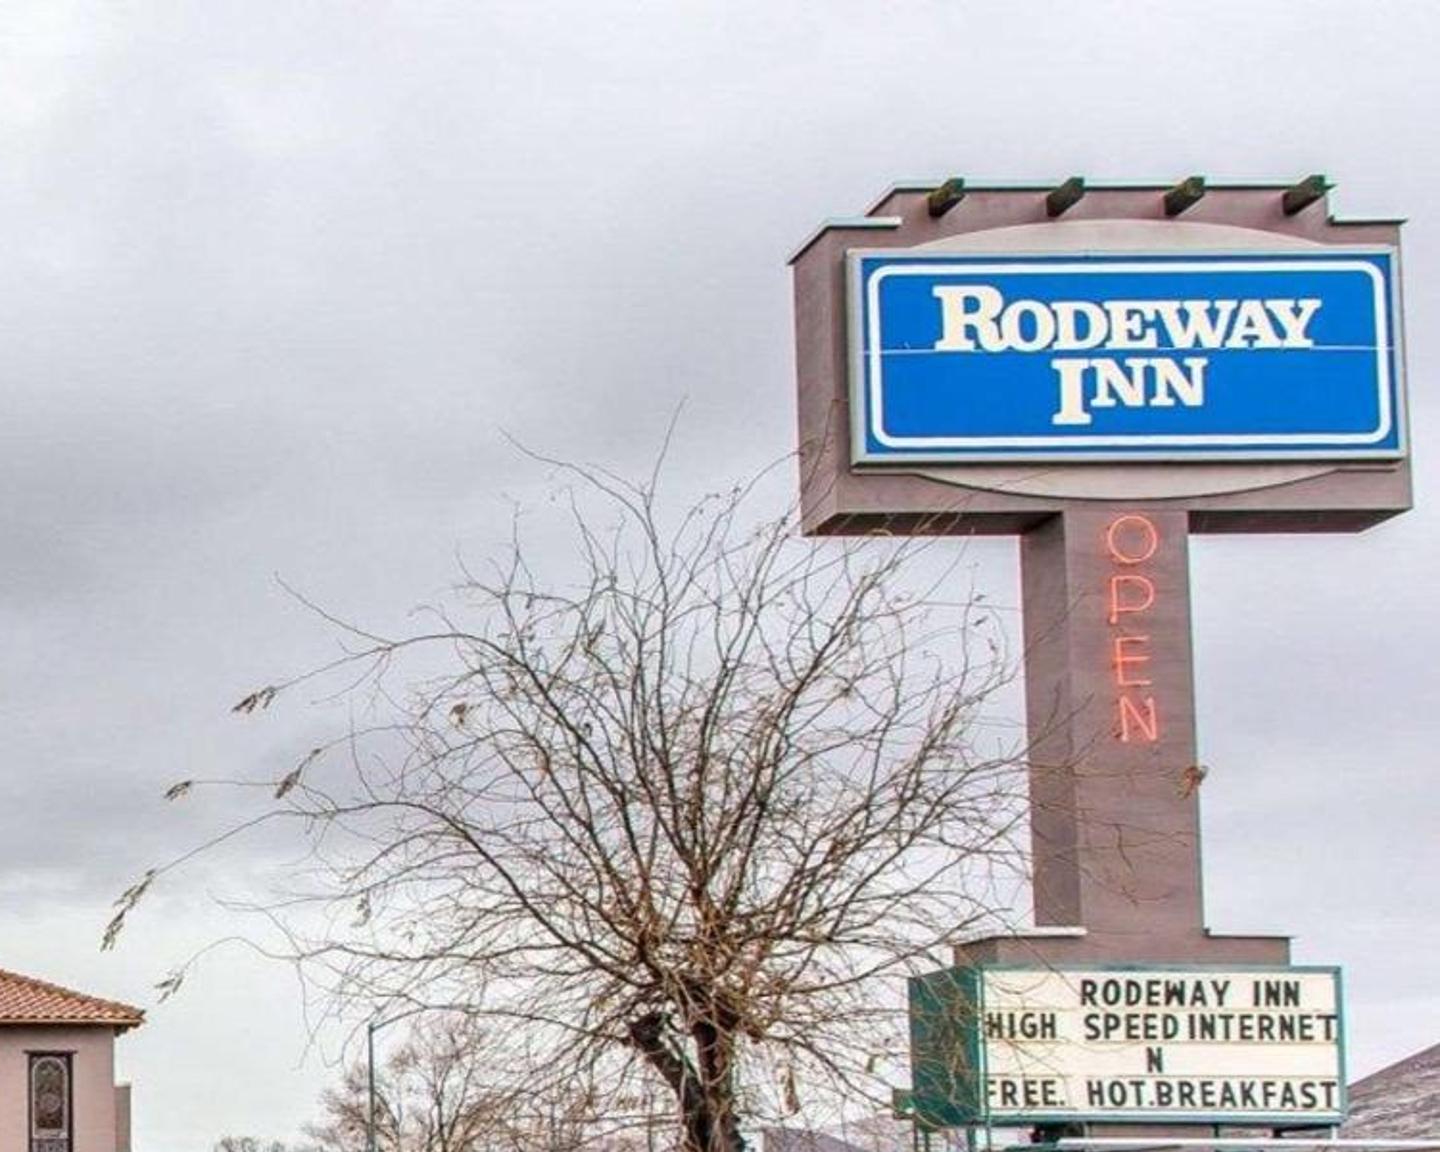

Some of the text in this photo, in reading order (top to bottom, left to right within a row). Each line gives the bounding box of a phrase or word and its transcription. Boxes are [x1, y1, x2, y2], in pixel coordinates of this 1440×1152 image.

[932, 284, 1321, 353] RODEWAY
[1051, 357, 1208, 426] INN
[1107, 514, 1158, 743] OPEN
[1080, 979, 1301, 1007] RODEWAY INN
[987, 1012, 1337, 1041] HIGH SPEED INTERNET
[1147, 1046, 1163, 1074] N
